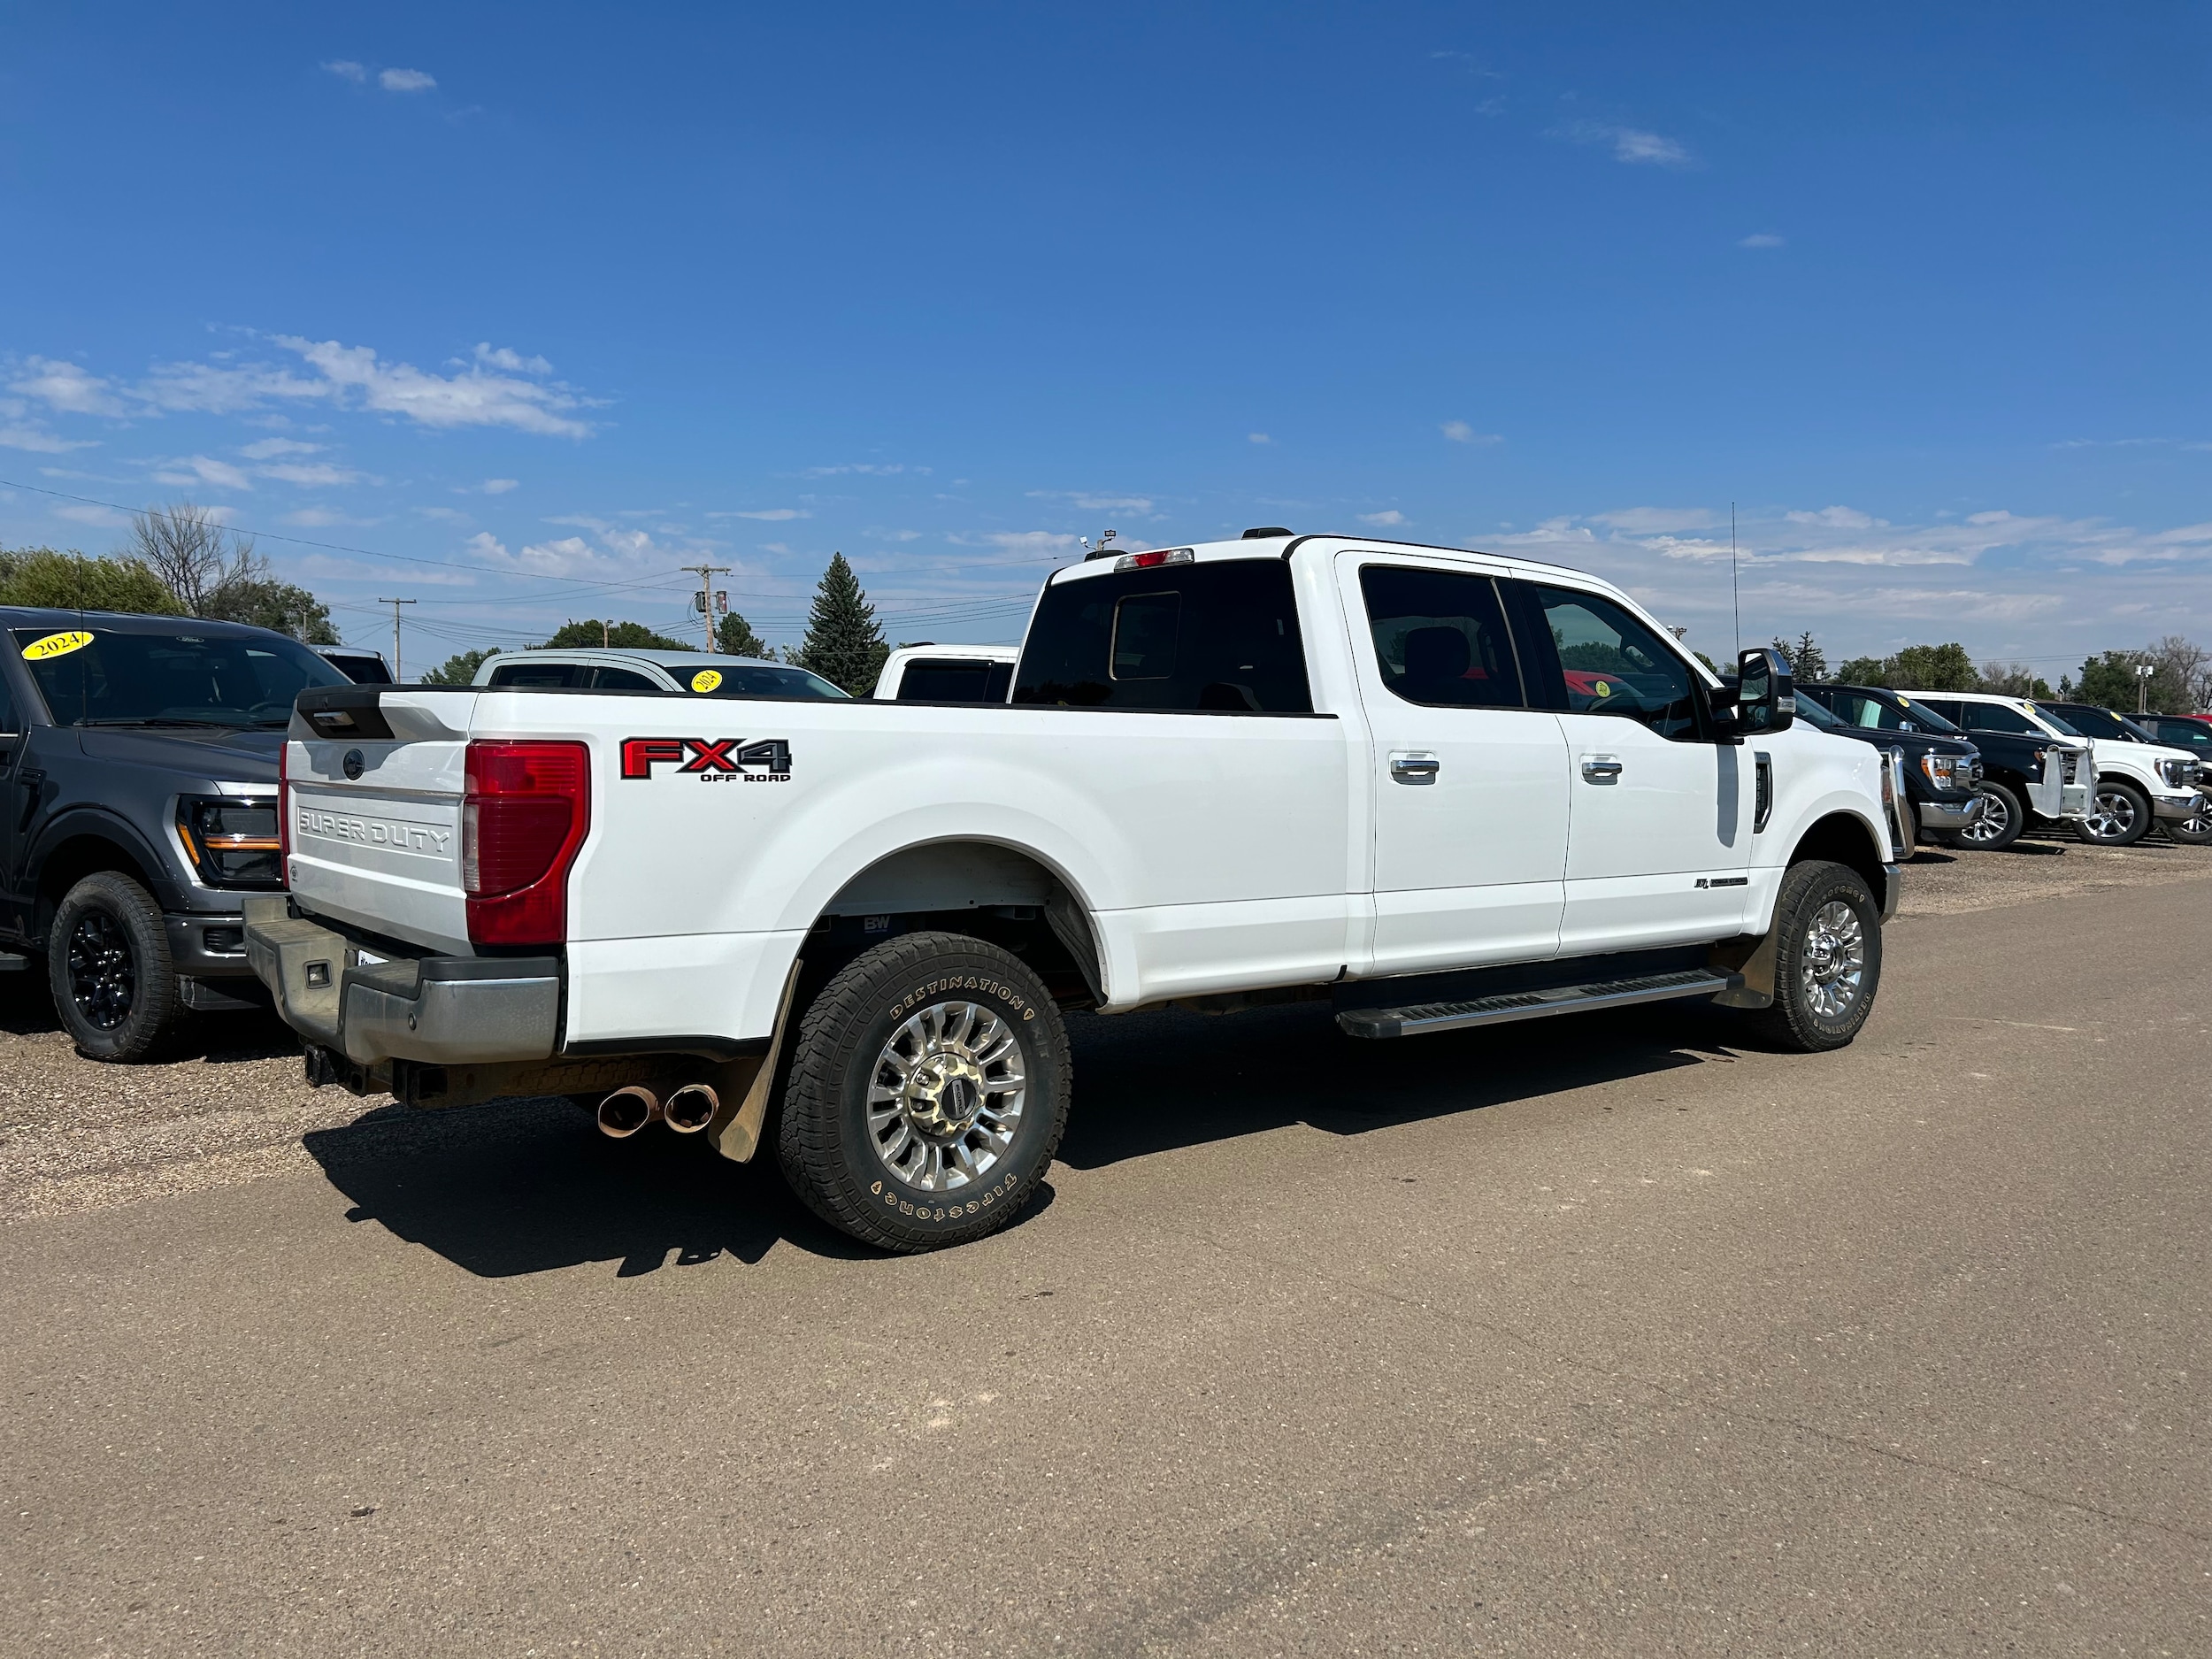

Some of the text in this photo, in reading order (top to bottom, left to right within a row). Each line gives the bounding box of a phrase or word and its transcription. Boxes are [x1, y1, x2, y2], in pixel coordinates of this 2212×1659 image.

[35, 633, 80, 657] 2024
[696, 671, 717, 690] 2024
[619, 736, 792, 780] FX4
[743, 773, 791, 782] ROAD
[300, 811, 450, 853] SUPER DUTY
[889, 975, 1025, 1020] DESTINATION
[885, 1172, 1018, 1222] Firestone
